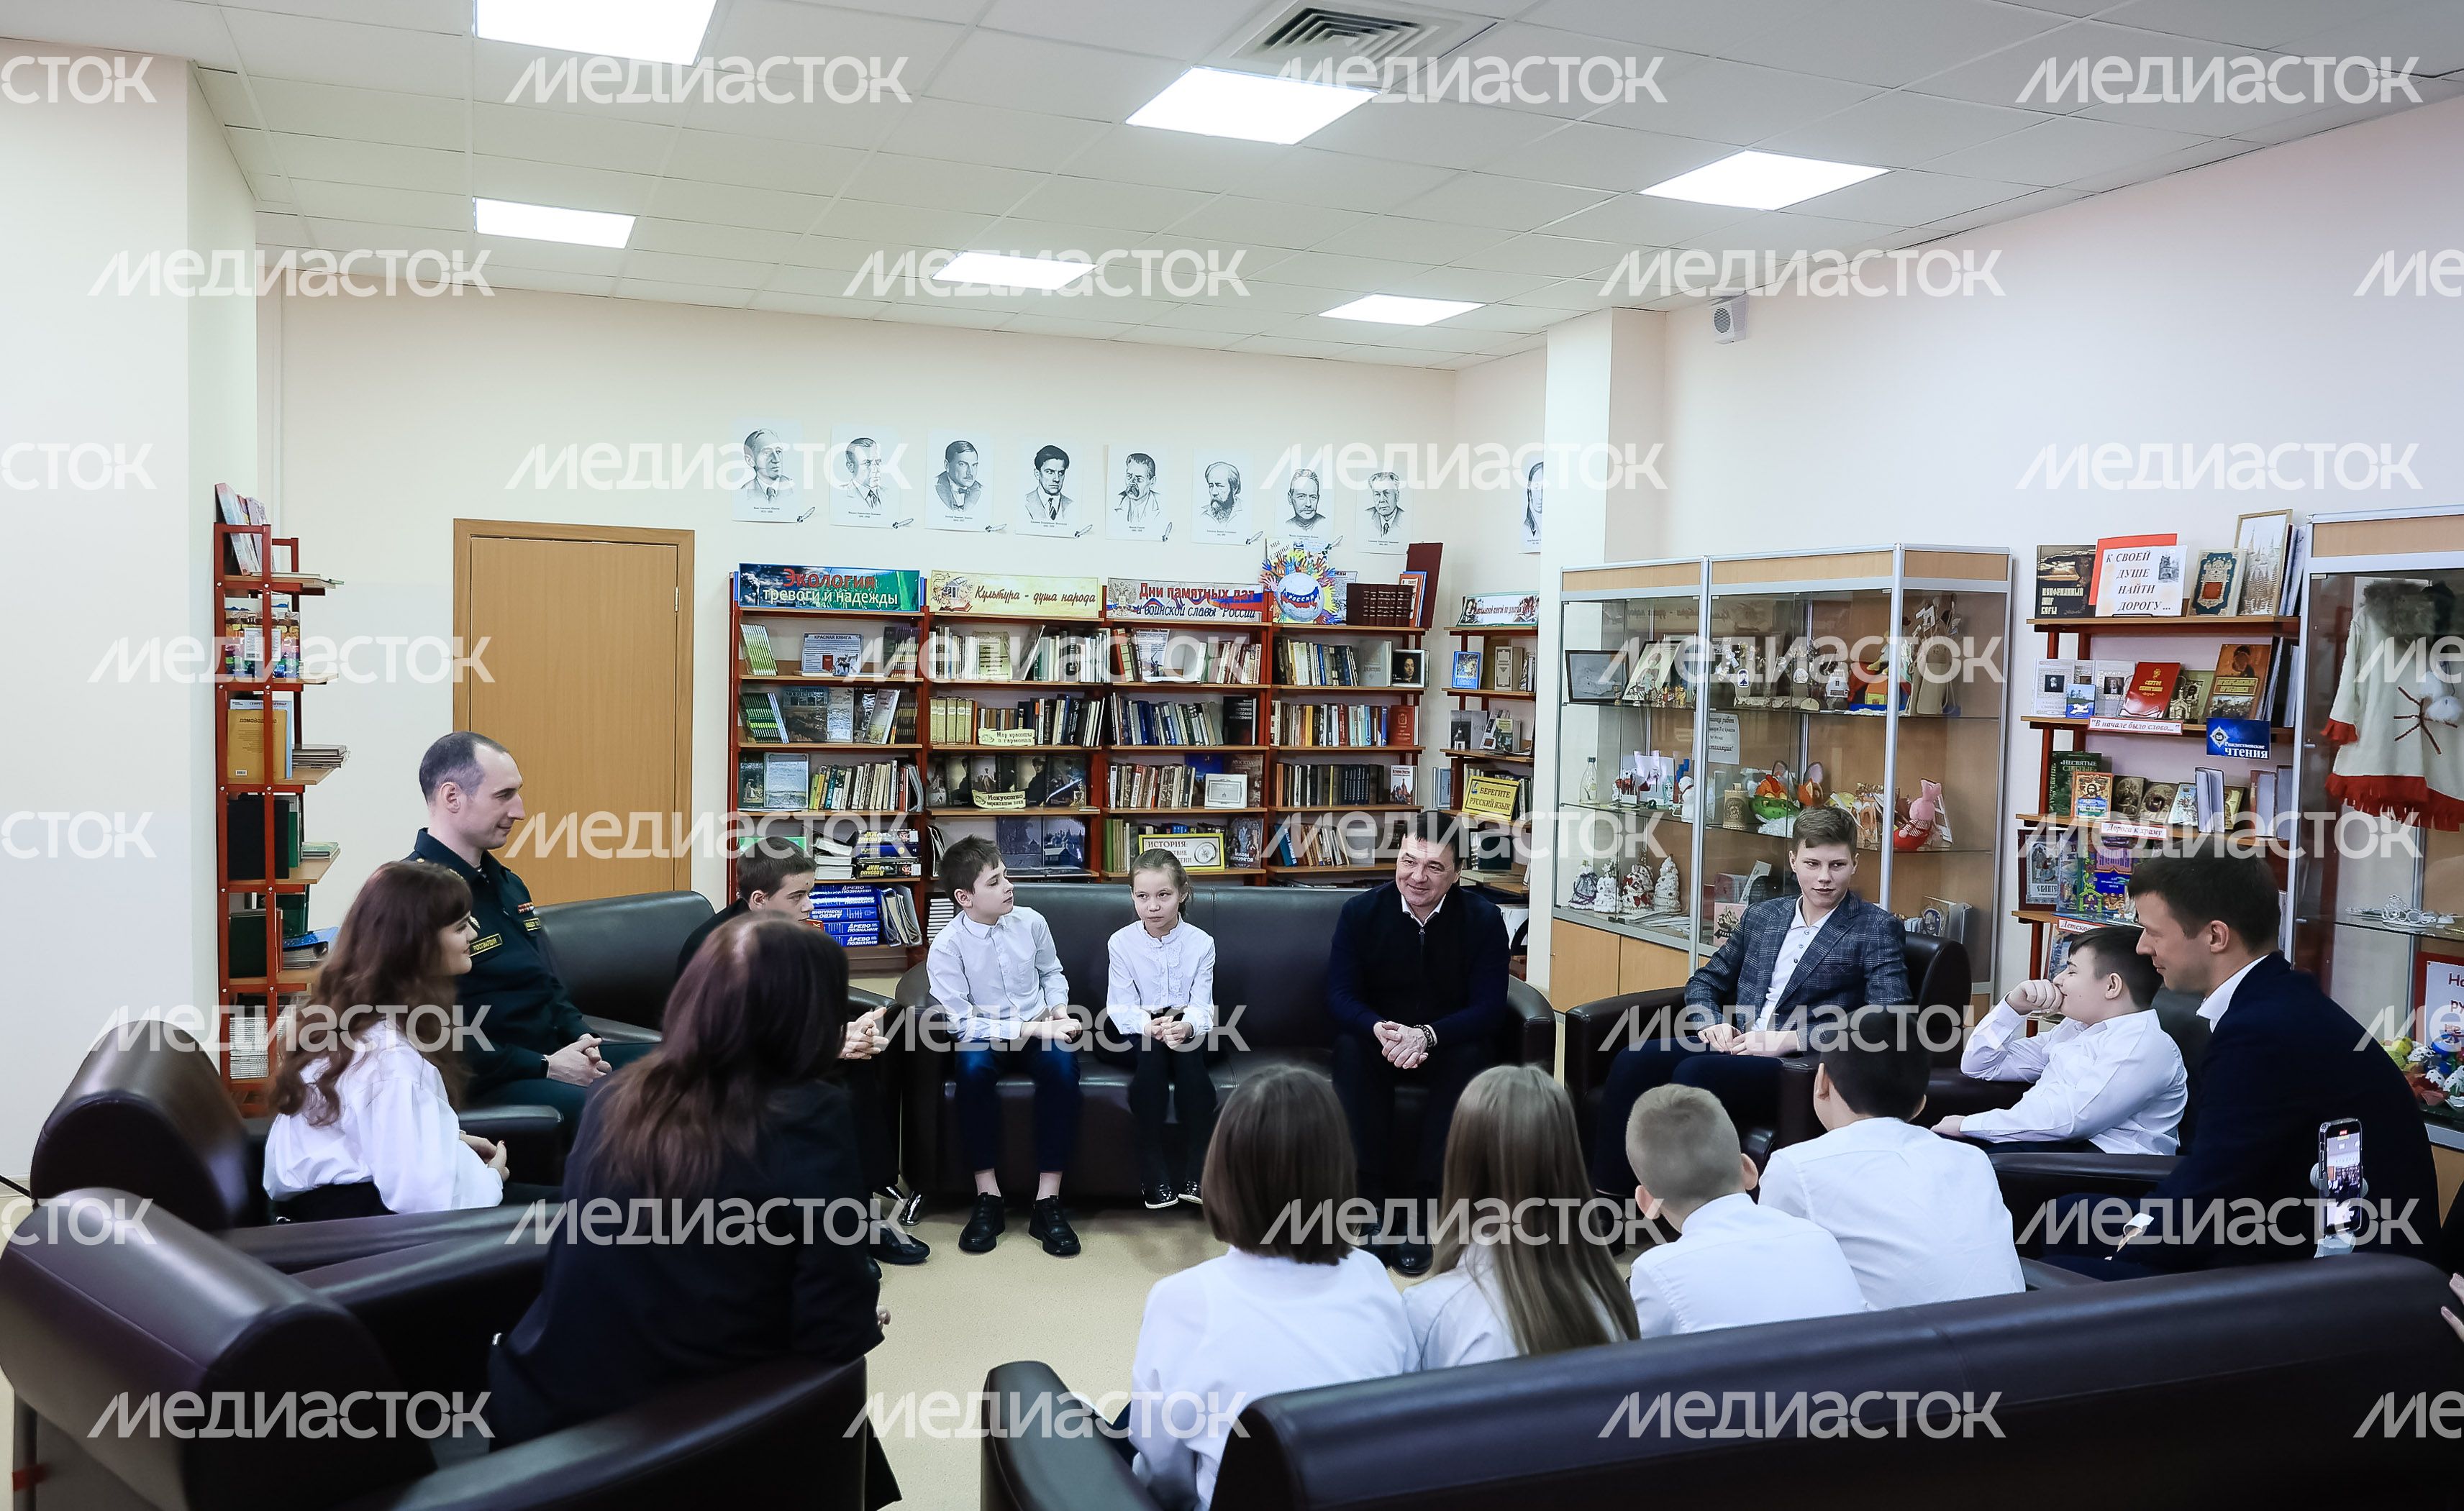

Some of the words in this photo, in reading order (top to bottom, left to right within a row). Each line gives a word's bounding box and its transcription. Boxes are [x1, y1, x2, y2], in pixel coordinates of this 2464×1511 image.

[2106, 553, 2114, 563] К
[2116, 550, 2152, 563] СВОЕЙ
[783, 568, 876, 590] Экология
[2116, 567, 2150, 580] ДУШЕ
[974, 585, 1020, 604] Культура
[1033, 593, 1058, 606] душа
[1061, 593, 1096, 606] народа
[1139, 583, 1163, 600] Дни
[1167, 586, 1229, 600] памятных
[2118, 583, 2156, 595] НАЙТИ
[763, 587, 820, 604] тревоги
[823, 591, 832, 602] и
[836, 591, 899, 610] надежды
[1145, 604, 1186, 617] воинской
[1188, 606, 1216, 617] славы
[1222, 607, 1255, 618] России
[2101, 721, 2125, 729] начале
[2128, 721, 2146, 730] было
[1480, 787, 1511, 799] БЕРЕГИТЕ
[1469, 798, 1494, 808] РУССКИЙ
[1494, 801, 1511, 811] ЯЗЫК
[2107, 823, 2132, 834] Дорога
